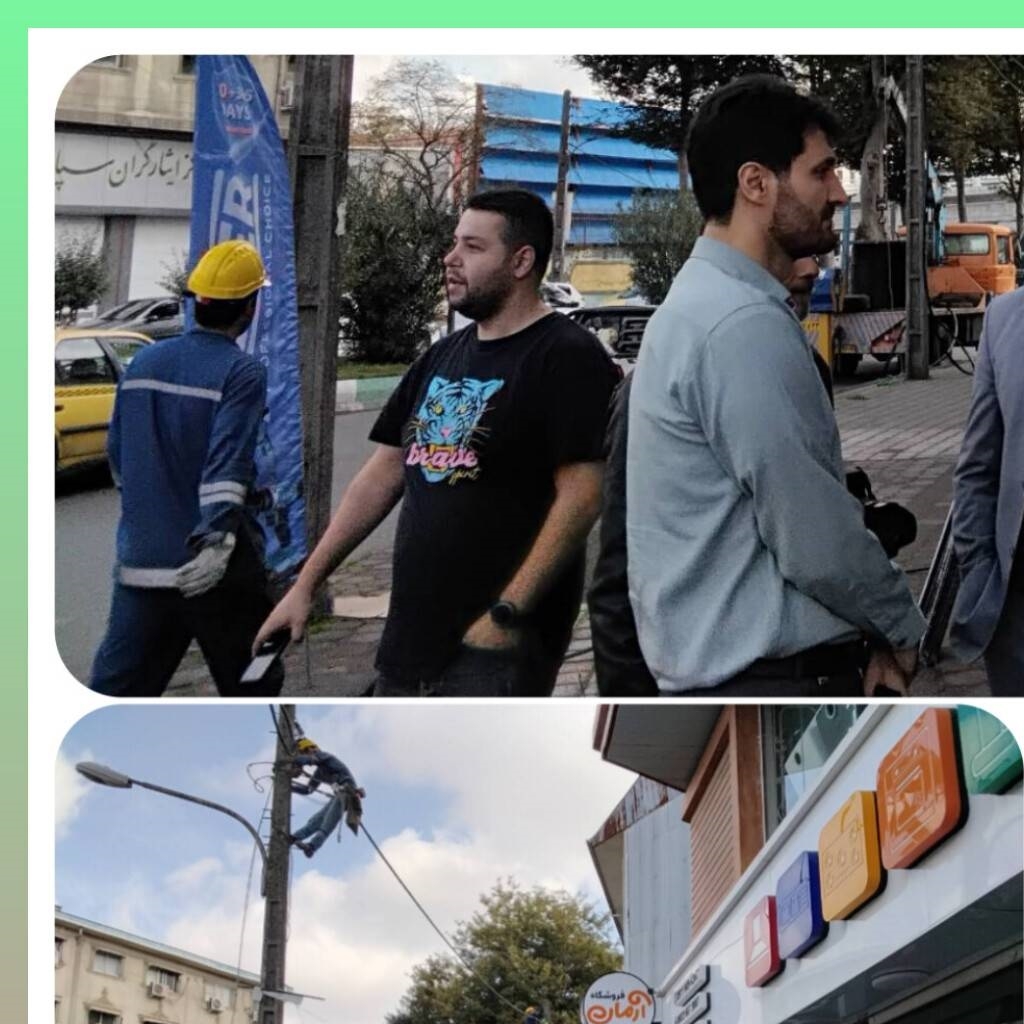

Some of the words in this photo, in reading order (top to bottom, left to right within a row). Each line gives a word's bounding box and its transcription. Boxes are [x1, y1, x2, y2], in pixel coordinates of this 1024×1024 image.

[55, 149, 115, 190] سپا
[263, 174, 273, 243] CHOICE
[406, 442, 478, 468] brave
